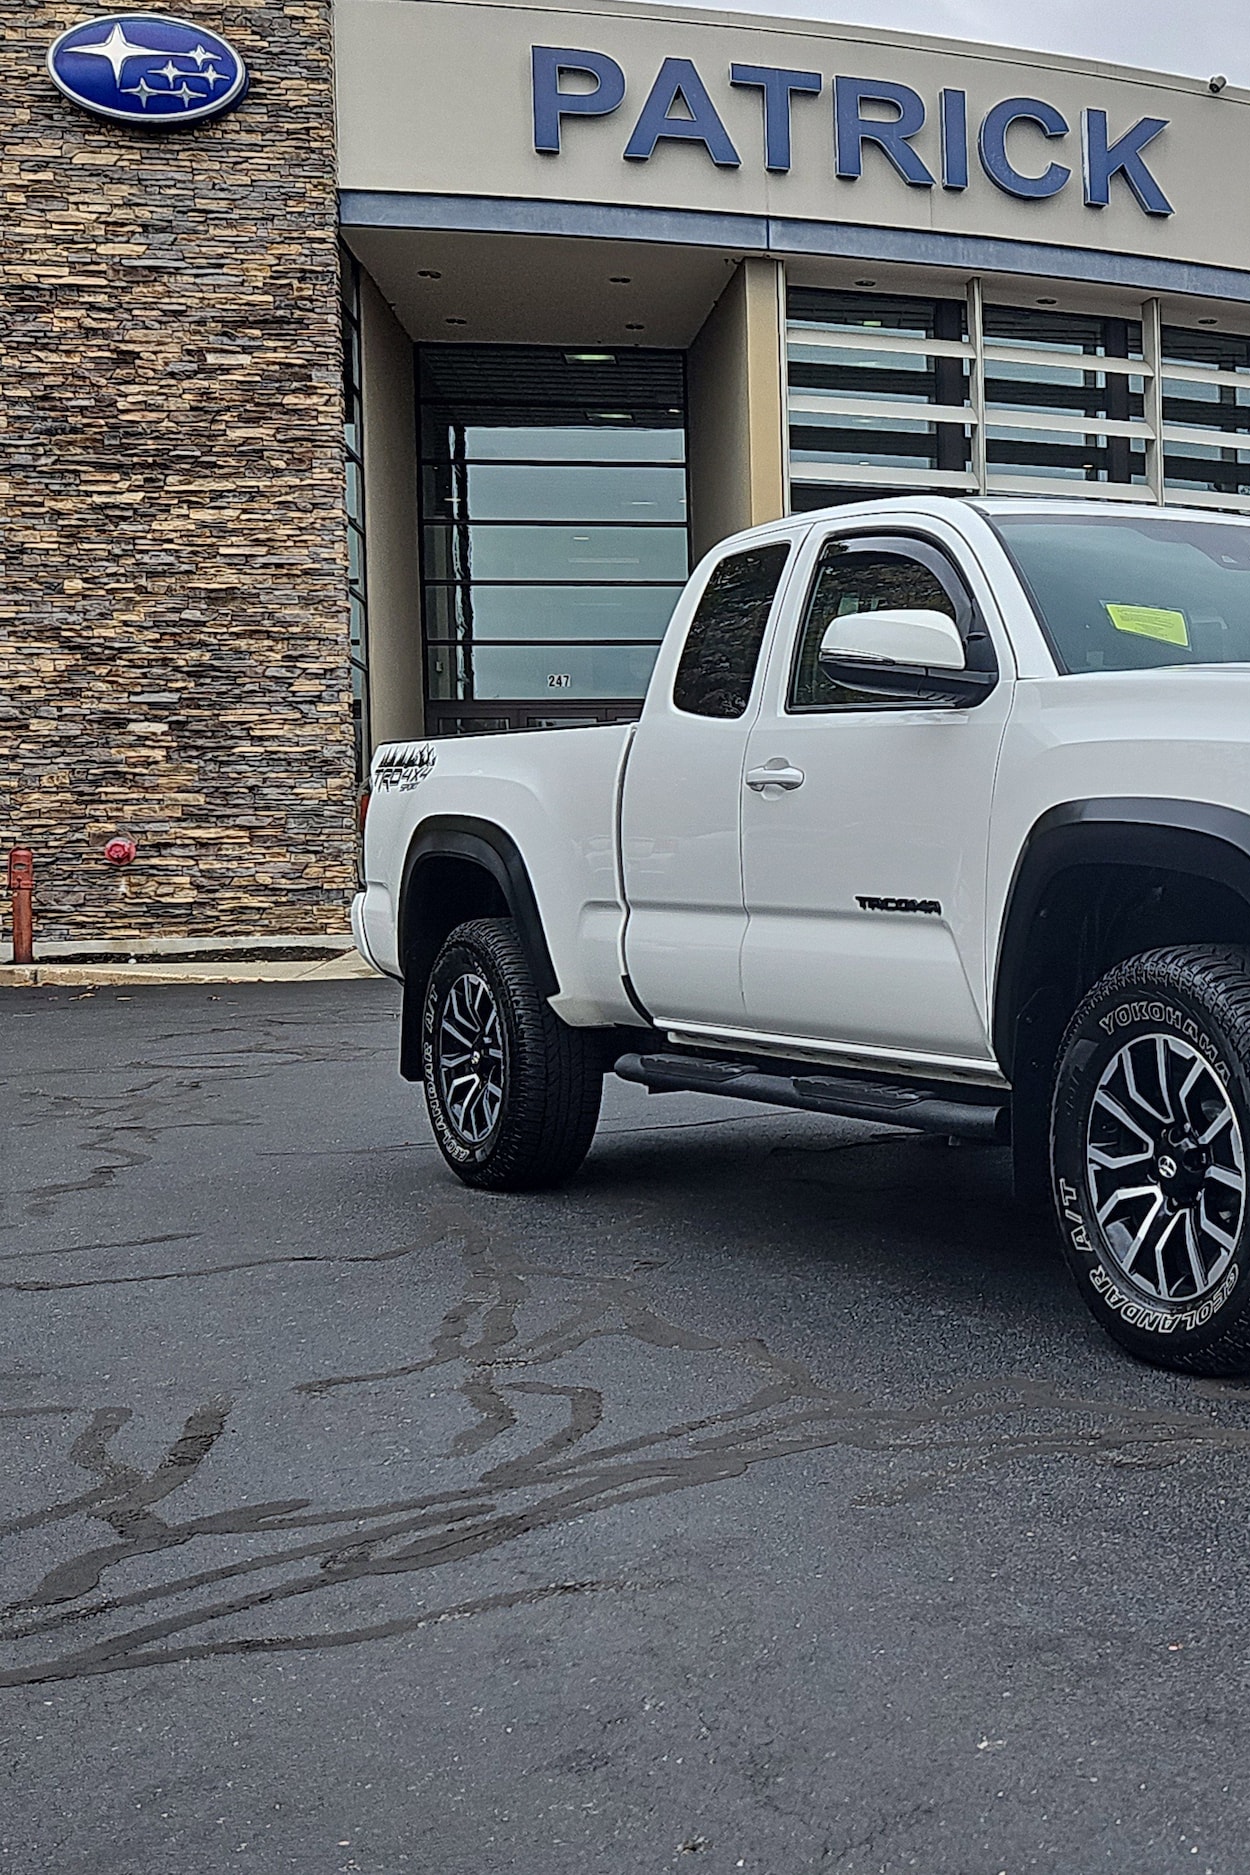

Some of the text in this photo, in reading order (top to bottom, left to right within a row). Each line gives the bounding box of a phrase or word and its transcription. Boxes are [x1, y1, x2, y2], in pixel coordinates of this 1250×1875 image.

[530, 44, 1175, 218] PATRICK
[548, 675, 570, 688] 247
[855, 896, 942, 916] TACOMA
[1099, 1000, 1231, 1085] YOKOHAMA
[1059, 1177, 1093, 1254] A/T
[1088, 1263, 1239, 1333] GEOLANDAR
